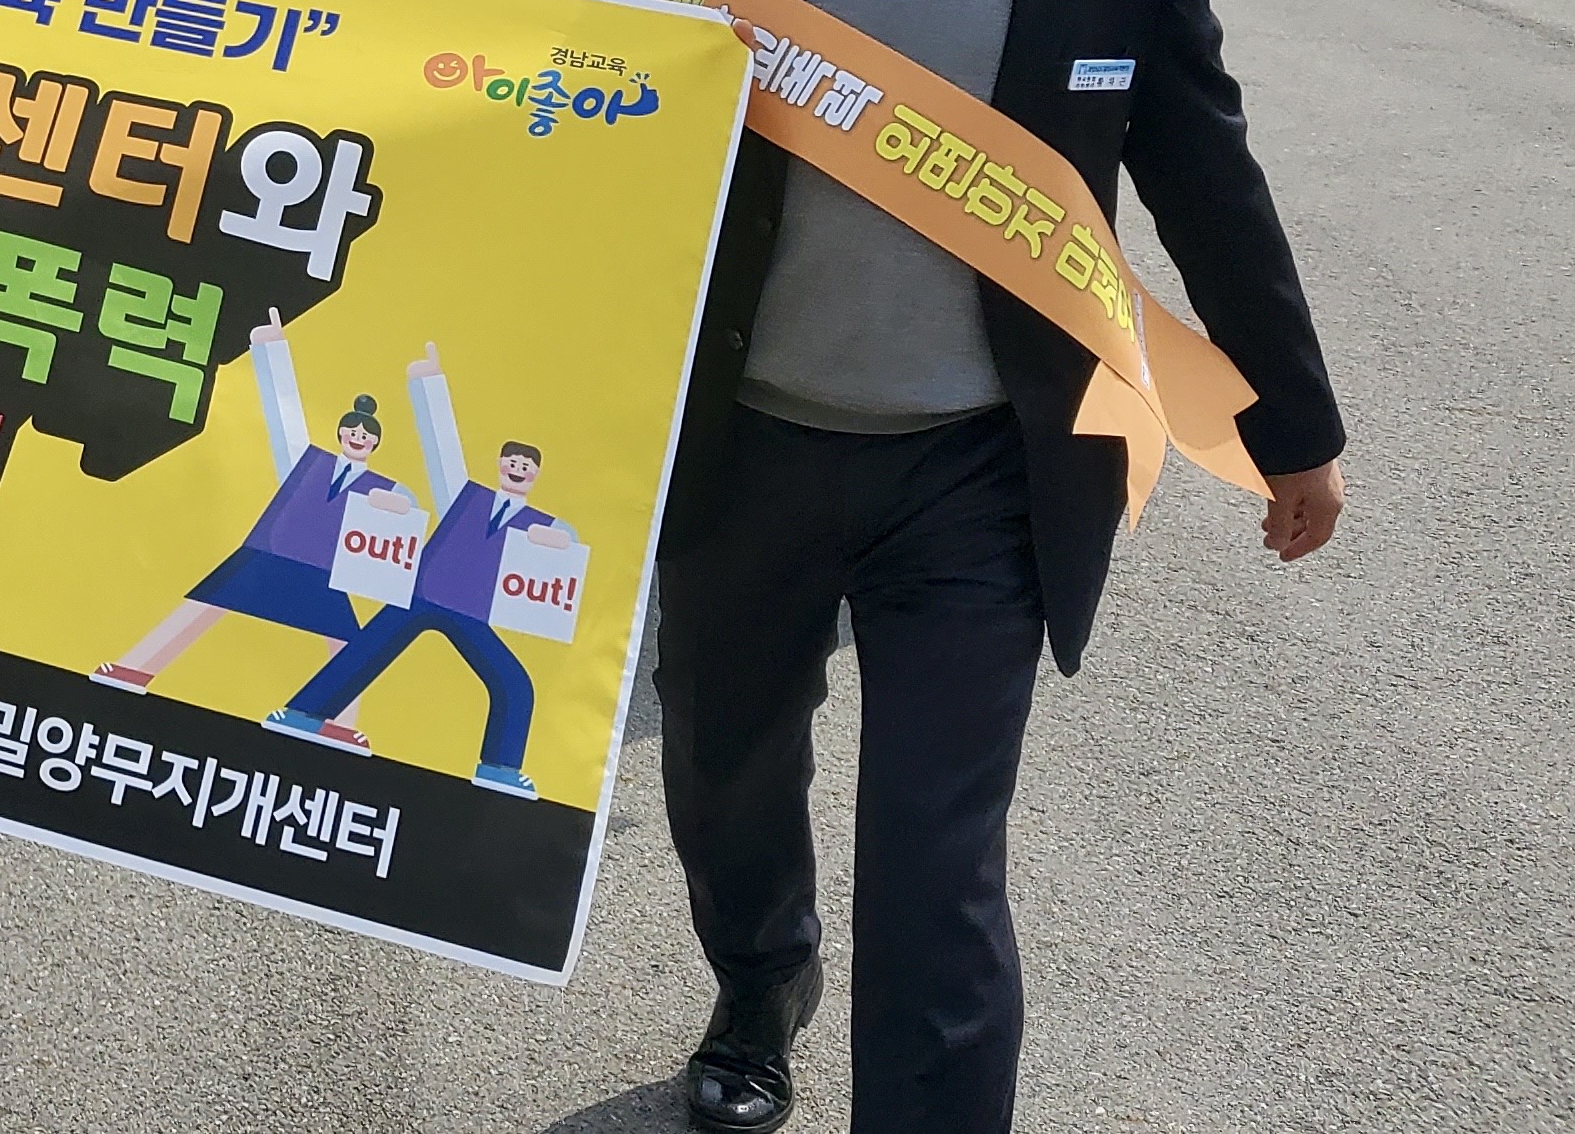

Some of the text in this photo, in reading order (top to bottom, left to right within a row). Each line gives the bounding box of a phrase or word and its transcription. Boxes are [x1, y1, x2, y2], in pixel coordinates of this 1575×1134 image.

[550, 46, 628, 77] 경남교육
[745, 21, 885, 132] 교폭력
[874, 104, 1066, 259] 외면하지
[343, 529, 418, 570] out!
[501, 572, 578, 612] out!
